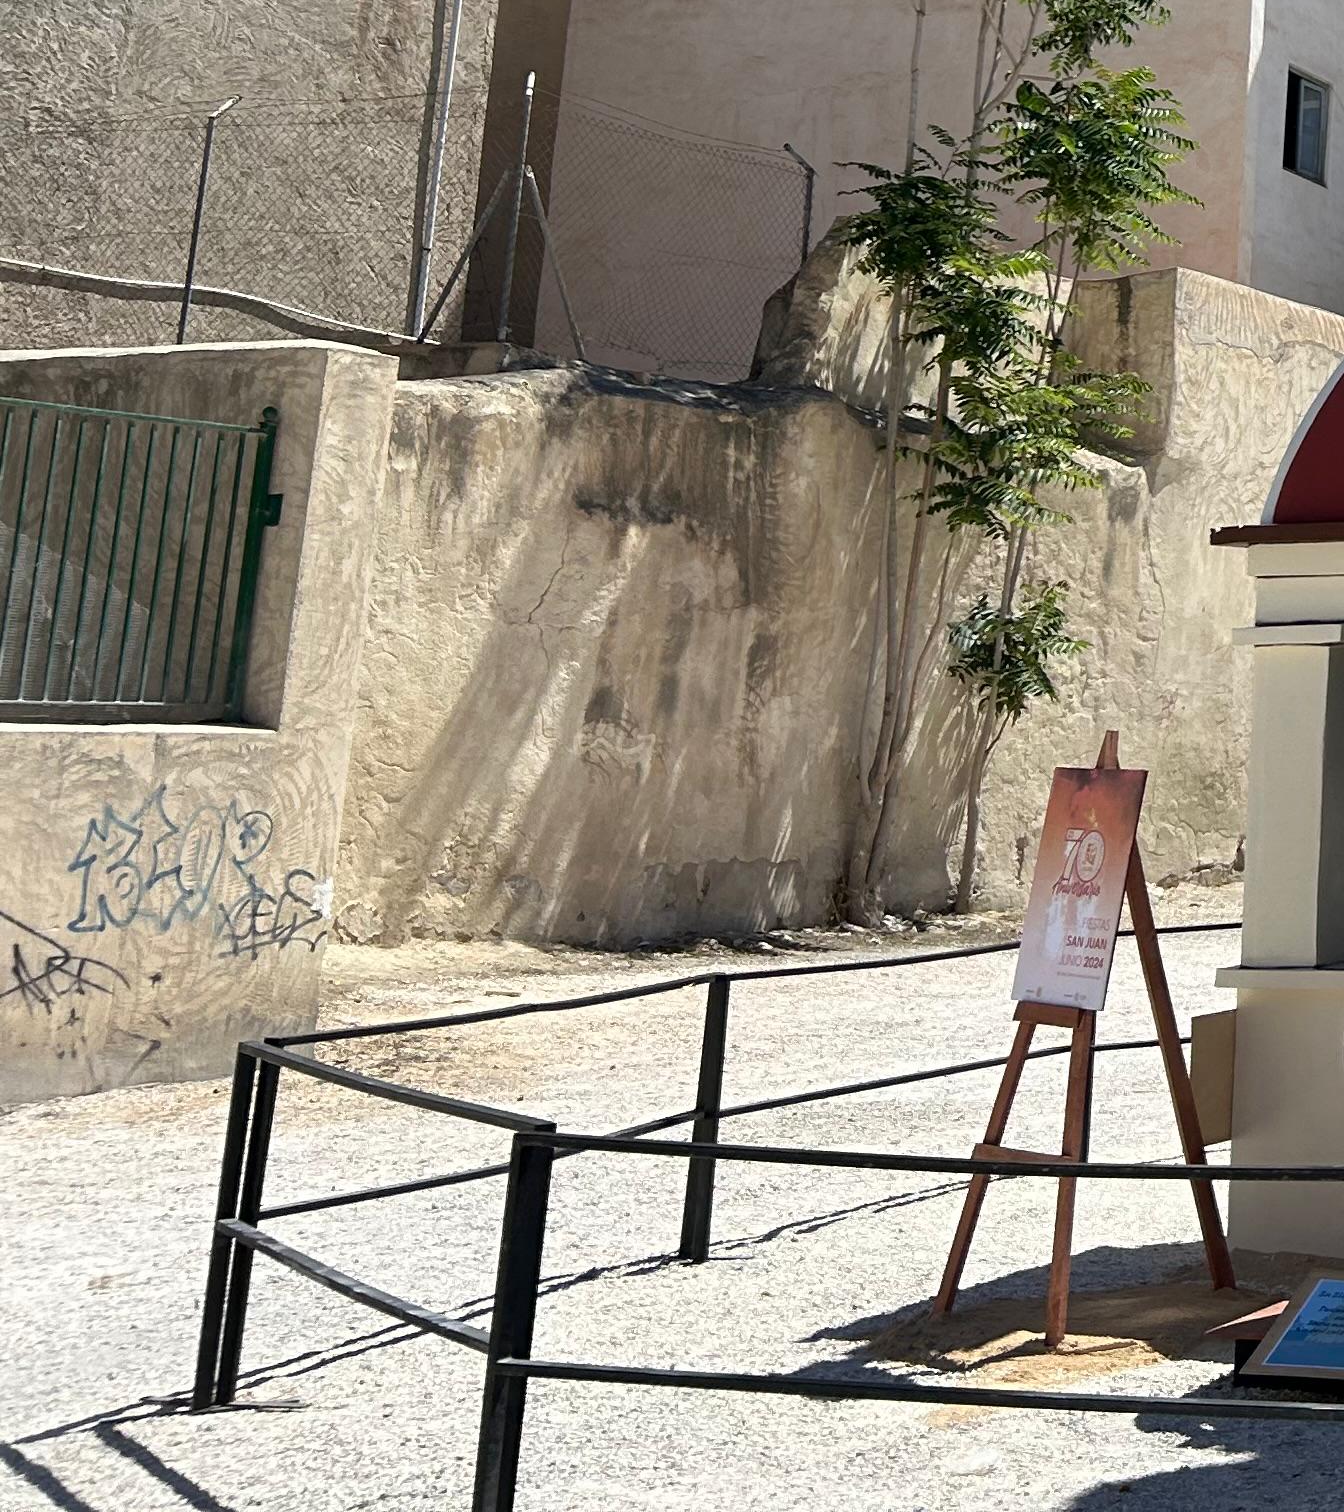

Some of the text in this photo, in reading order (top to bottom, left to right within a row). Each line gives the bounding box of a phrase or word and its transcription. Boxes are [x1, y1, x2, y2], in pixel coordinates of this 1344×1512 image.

[1062, 827, 1105, 883] 70
[1083, 916, 1111, 931] FIESTAS
[1066, 935, 1108, 950] SAN JUAN
[1058, 953, 1104, 969] JUNIO 2024
